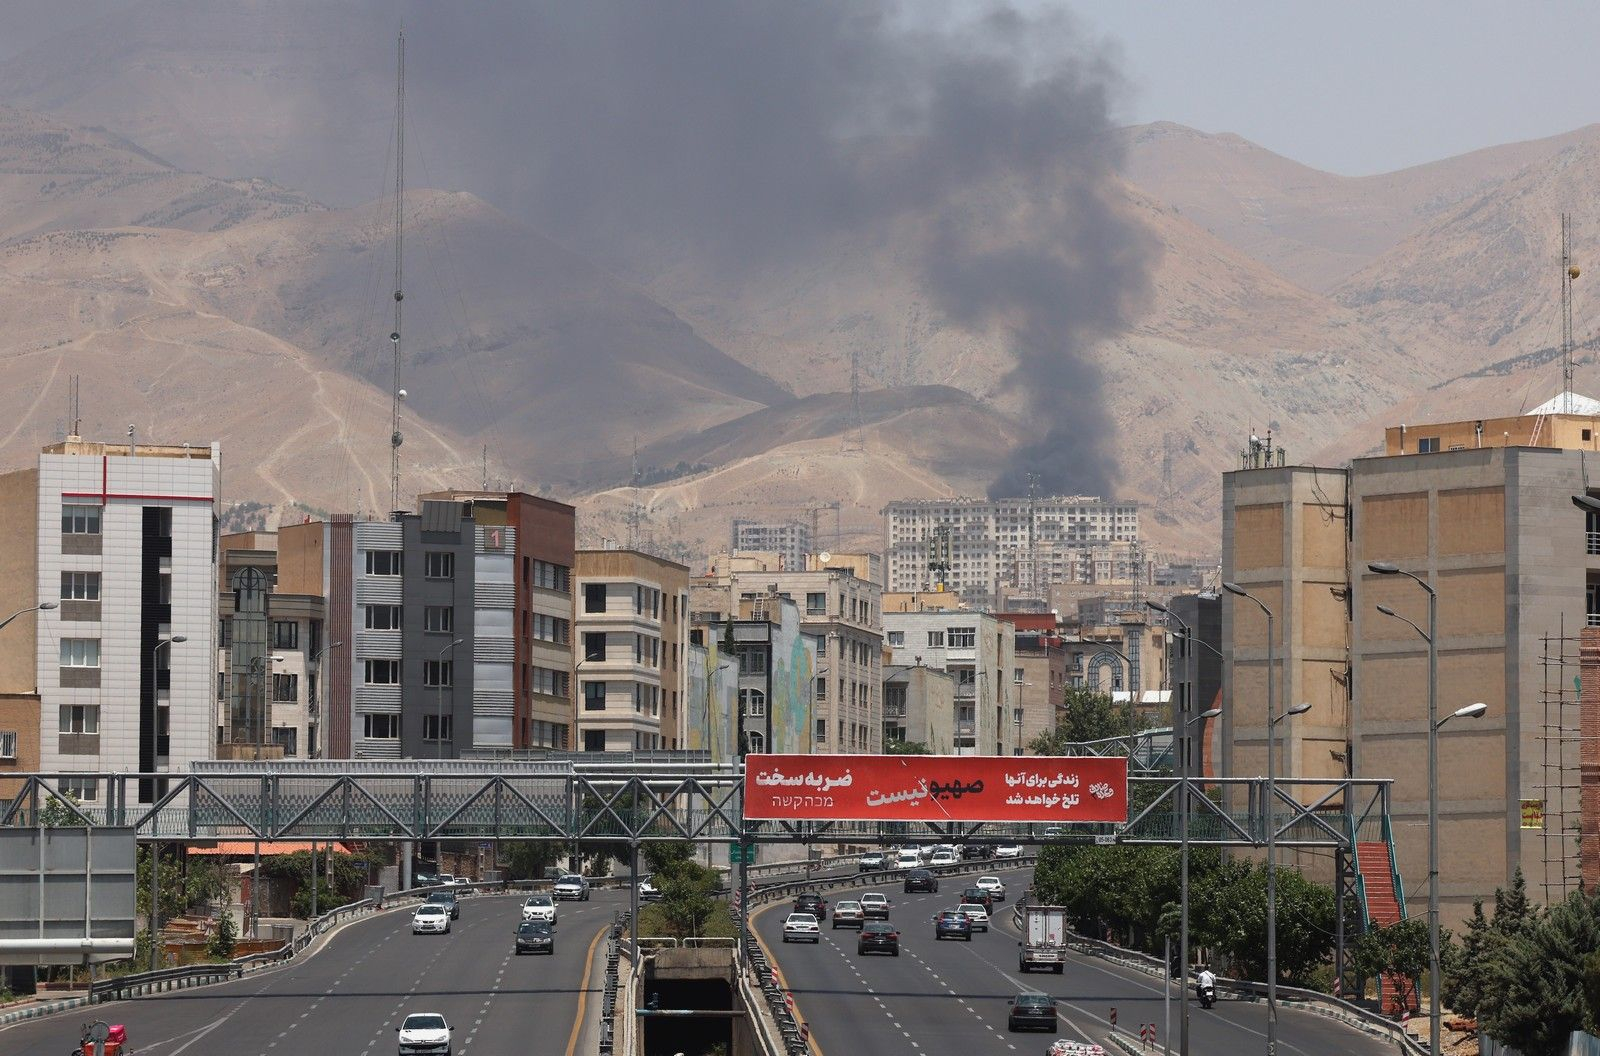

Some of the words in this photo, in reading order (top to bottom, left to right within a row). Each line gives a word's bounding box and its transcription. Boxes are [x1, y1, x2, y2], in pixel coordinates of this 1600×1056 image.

[755, 767, 804, 786] سخت
[805, 768, 853, 792] ضربه
[1004, 772, 1026, 787] آنها
[1026, 773, 1048, 788] برای
[1048, 772, 1080, 788] زندگی
[1006, 792, 1024, 805] شد
[1024, 793, 1062, 808] خواهد
[1062, 793, 1080, 809] تلخ
